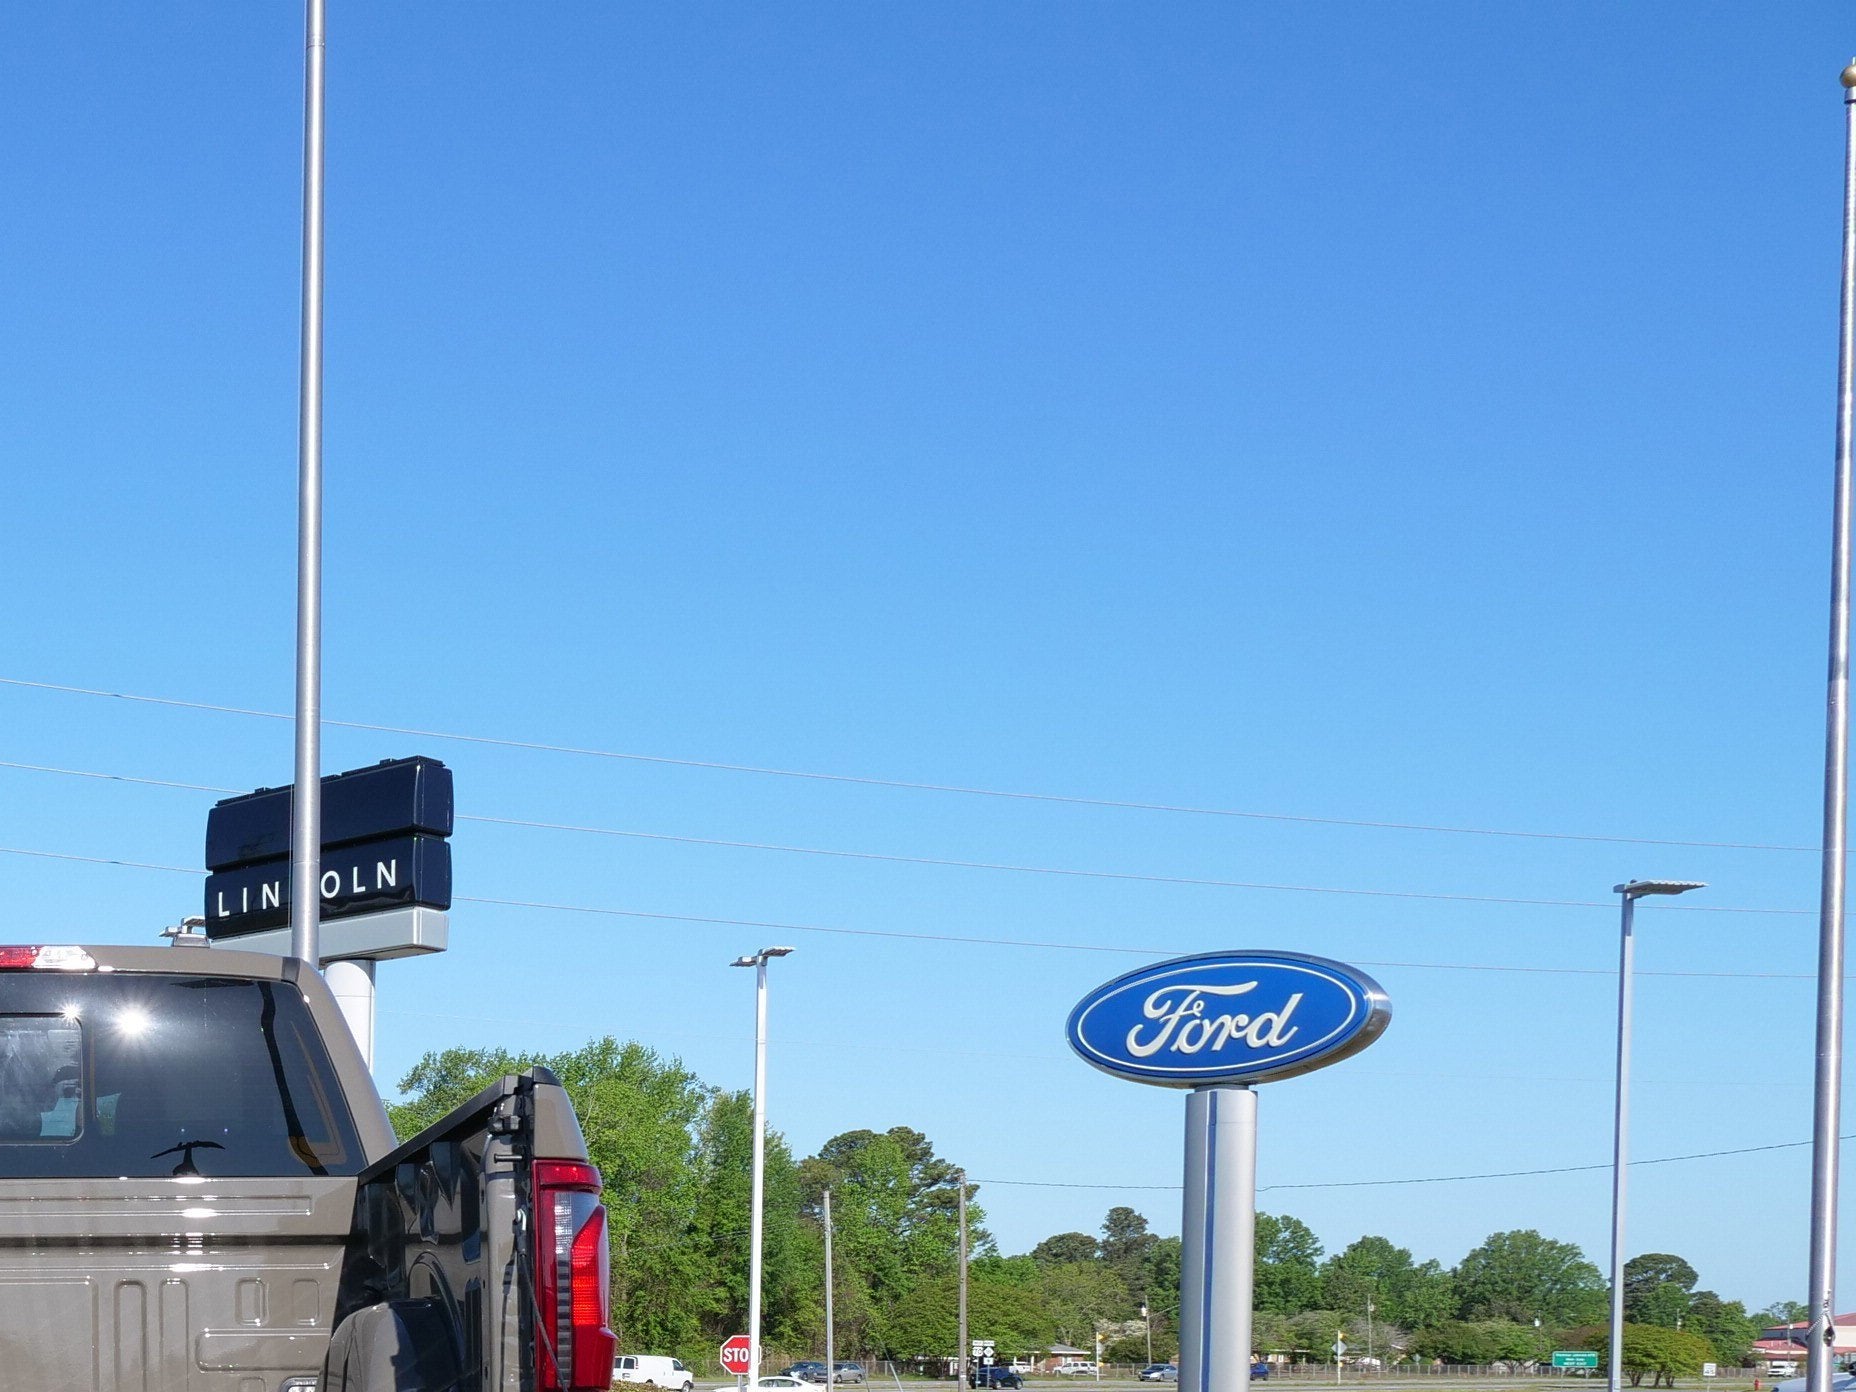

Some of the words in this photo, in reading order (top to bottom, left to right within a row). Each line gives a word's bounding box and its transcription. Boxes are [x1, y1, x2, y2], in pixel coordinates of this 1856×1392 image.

[218, 859, 397, 918] LINOLN
[1126, 980, 1304, 1058] Ford
[723, 1347, 749, 1362] STO
